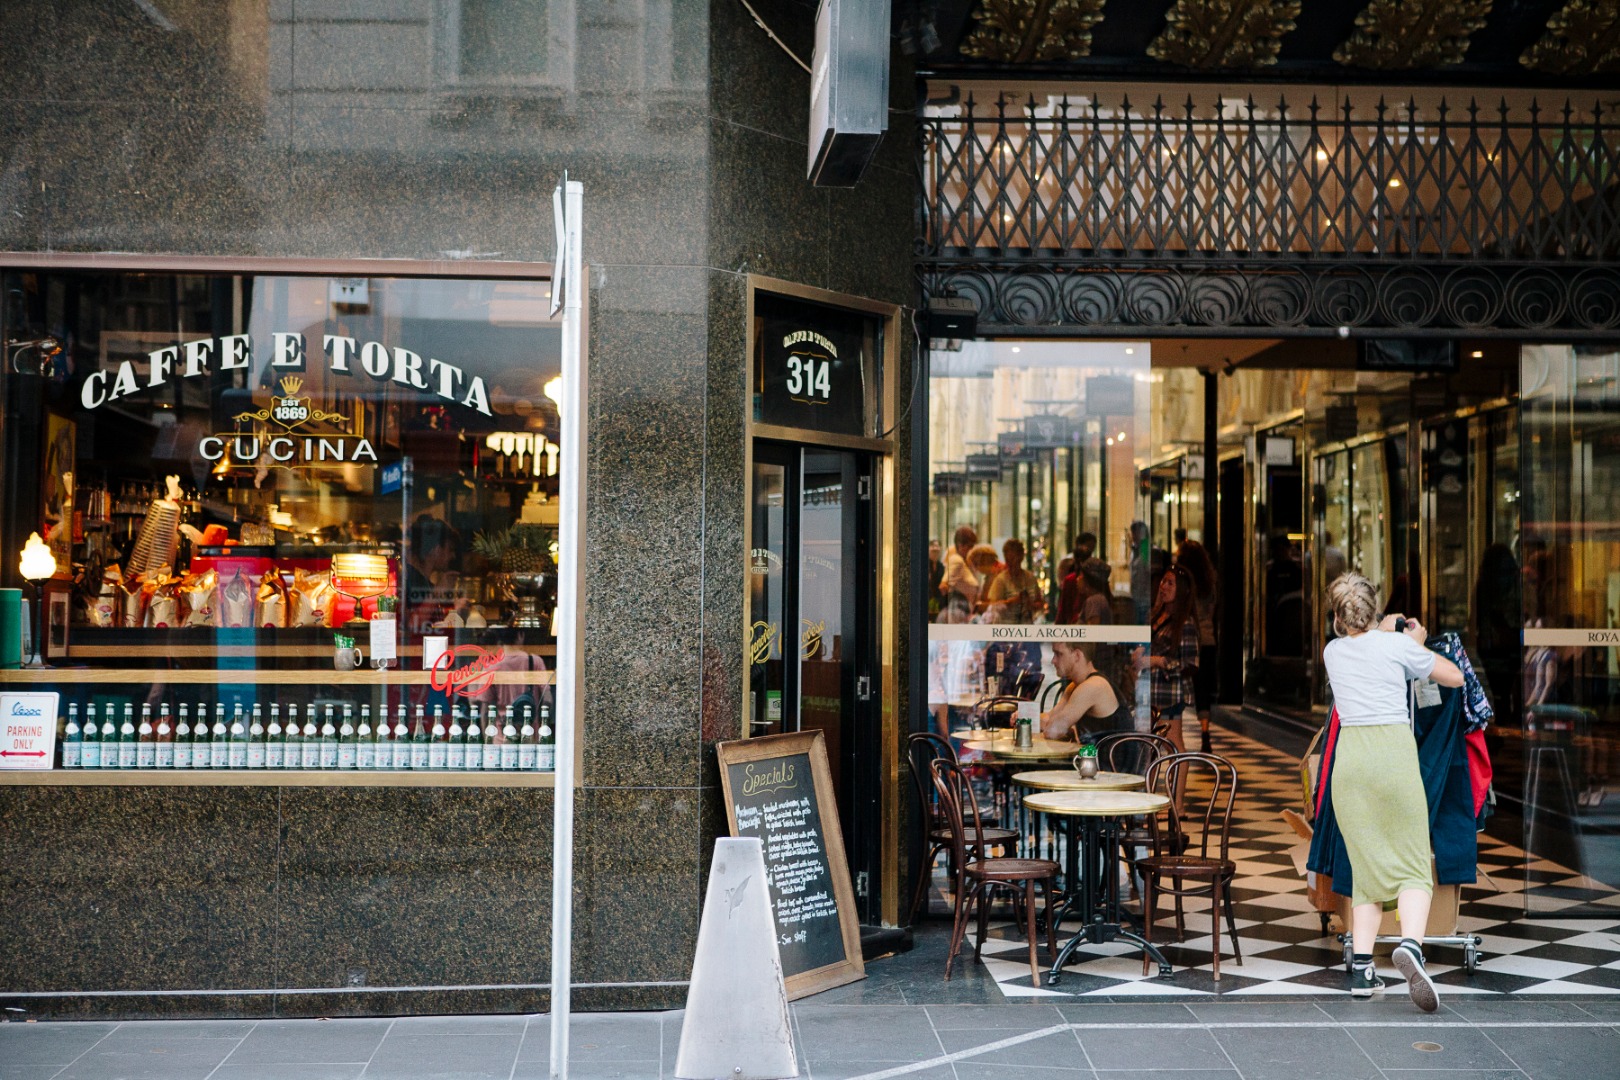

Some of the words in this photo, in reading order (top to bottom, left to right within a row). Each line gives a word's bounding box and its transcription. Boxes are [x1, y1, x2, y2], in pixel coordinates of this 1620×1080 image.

[80, 334, 250, 410] CAFFE
[271, 332, 302, 367] E
[323, 334, 493, 417] TORTA
[786, 355, 831, 399] 314
[281, 399, 300, 407] EST
[274, 406, 308, 420] 1869
[199, 437, 378, 462] CUCINA
[992, 627, 1032, 638] ROYAL
[1036, 628, 1087, 638] ARCADE
[431, 647, 505, 698] Genovese
[7, 725, 43, 737] PARKING
[13, 739, 34, 750] ONLY
[743, 761, 795, 793] Specials
